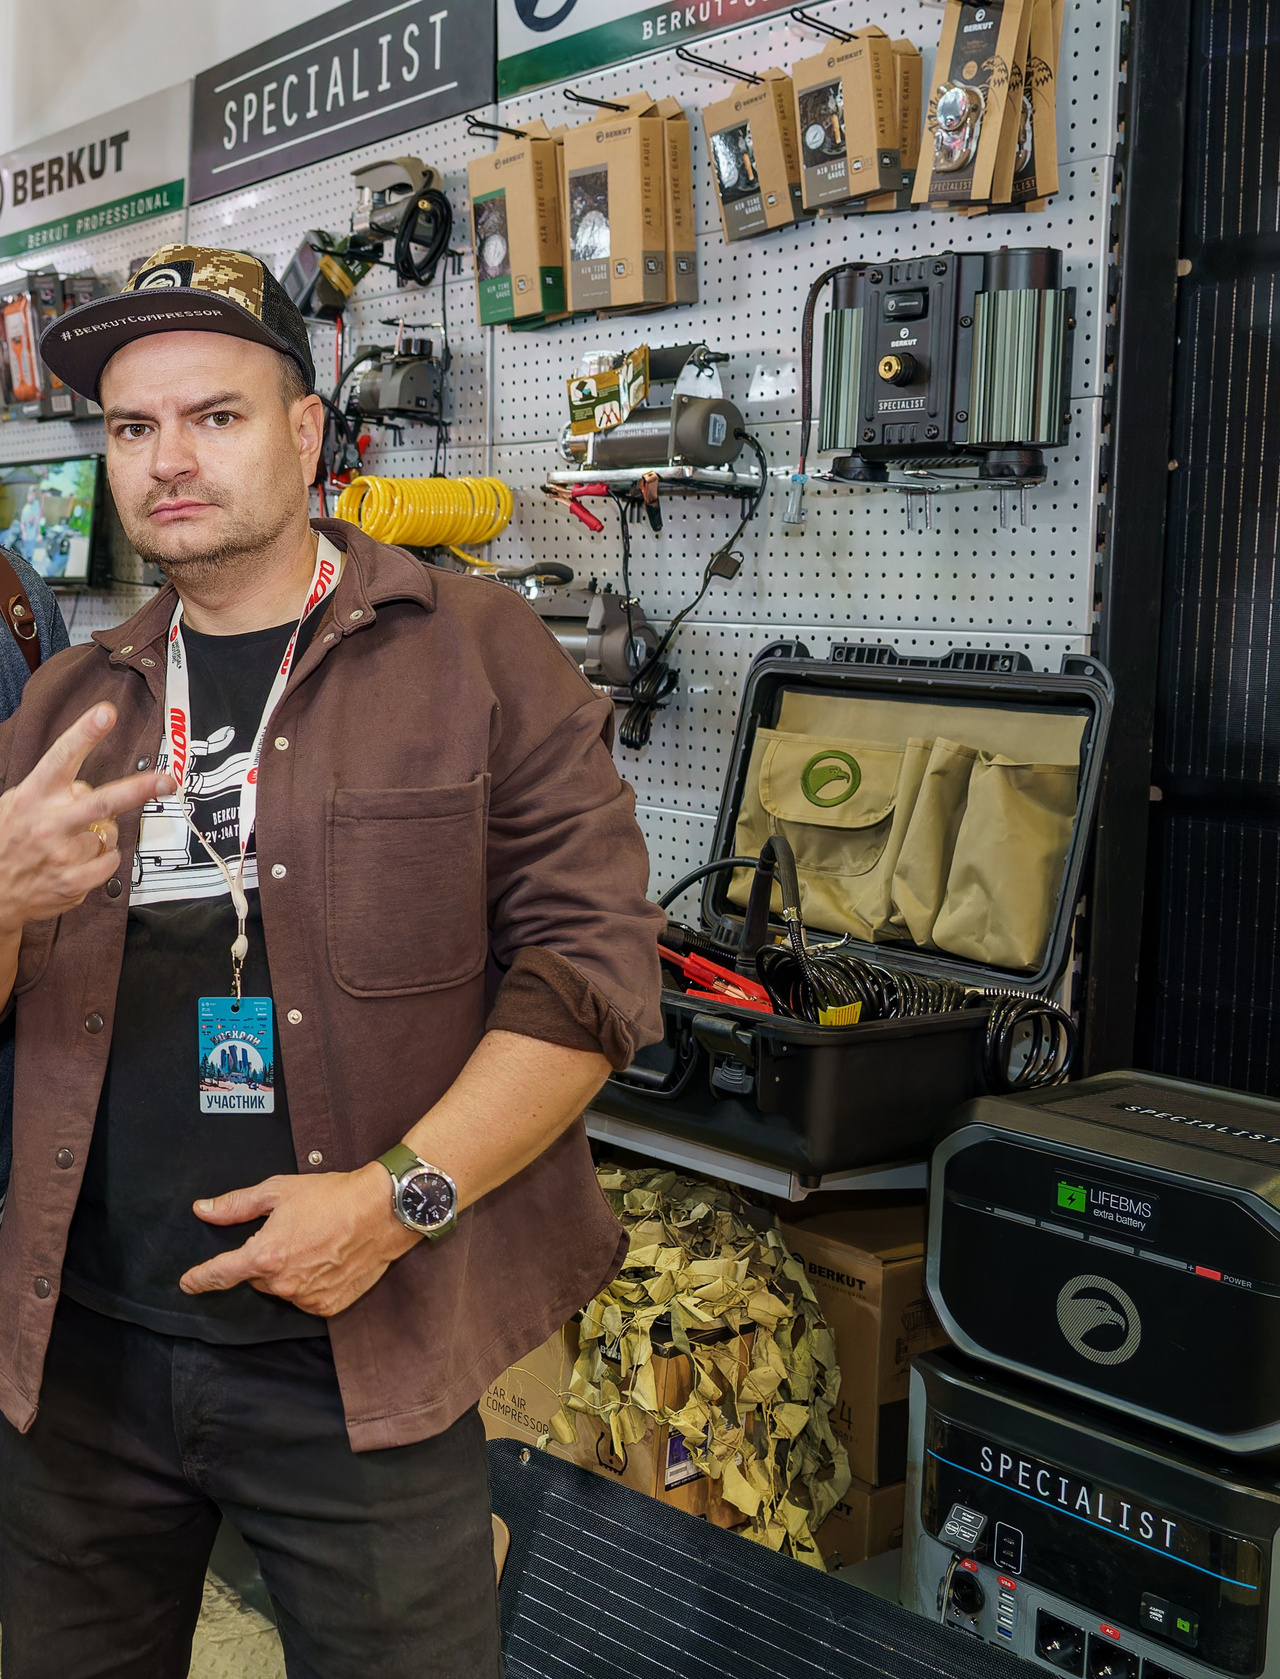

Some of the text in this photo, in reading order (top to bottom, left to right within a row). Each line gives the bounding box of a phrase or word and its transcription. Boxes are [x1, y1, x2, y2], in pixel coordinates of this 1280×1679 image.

[963, 21, 994, 33] BERKUT
[836, 49, 863, 63] BERKUT
[223, 10, 448, 150] SPECIALIST
[605, 127, 632, 139] BERKUT
[13, 130, 130, 207] BERKUT
[930, 181, 972, 192] SPECIALIST
[27, 191, 170, 249] BERKUT PROFESSIONAL
[891, 338, 918, 348] BERKUT
[879, 399, 924, 411] SPECIALIST
[170, 708, 187, 787] MOTO
[206, 1095, 265, 1109] УЧАСТНИК
[1125, 1105, 1280, 1144] SPECIALIST
[1090, 1188, 1152, 1218] LIFEBMS
[1093, 1208, 1147, 1232] extra battery
[809, 1262, 866, 1291] BERKUT
[1223, 1274, 1253, 1289] POWER
[510, 1394, 527, 1411] AIR
[486, 1397, 550, 1435] COMPRESSOR
[980, 1446, 1177, 1548] SPECIALIST
[1105, 1628, 1114, 1636] AC
